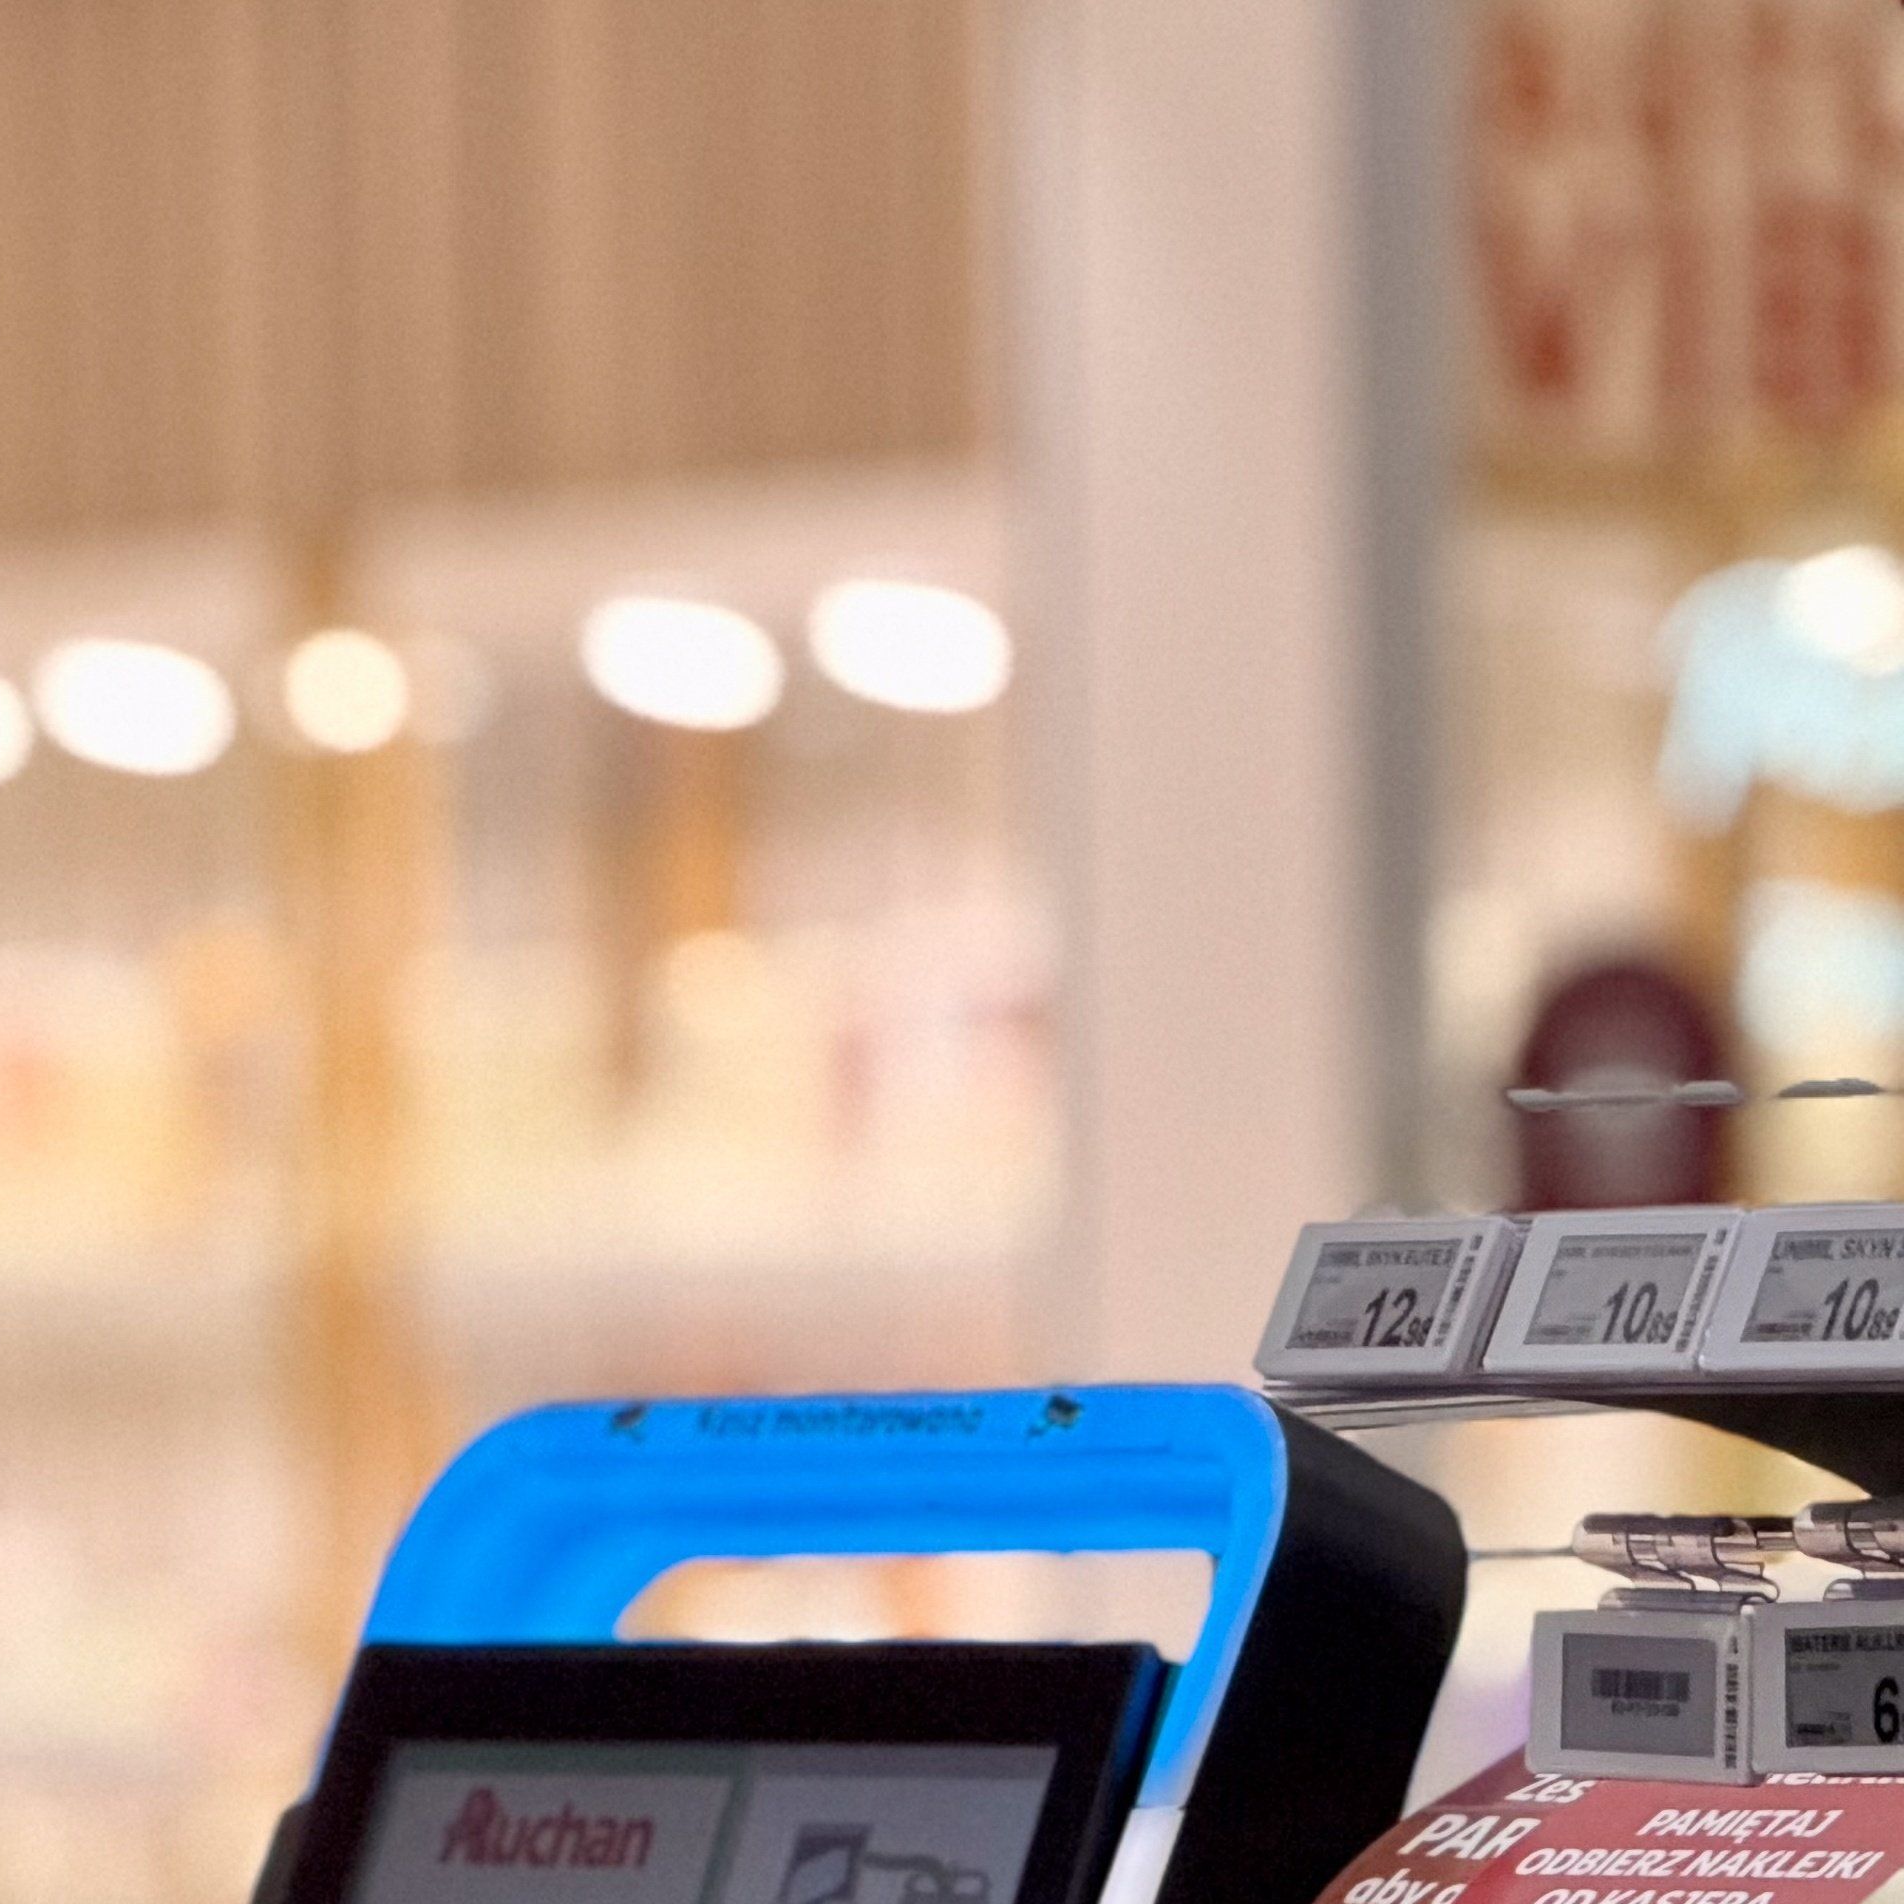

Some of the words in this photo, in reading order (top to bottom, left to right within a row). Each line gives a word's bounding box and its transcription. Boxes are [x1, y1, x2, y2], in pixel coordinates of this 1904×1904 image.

[436, 1786, 656, 1871] Auchan
[1397, 1814, 1542, 1860] PAR
[1636, 1809, 1843, 1844] PAMIĘTAJ
[1515, 1848, 1695, 1877] ODBIERZ
[1687, 1850, 1885, 1880] NAKLEJKI
